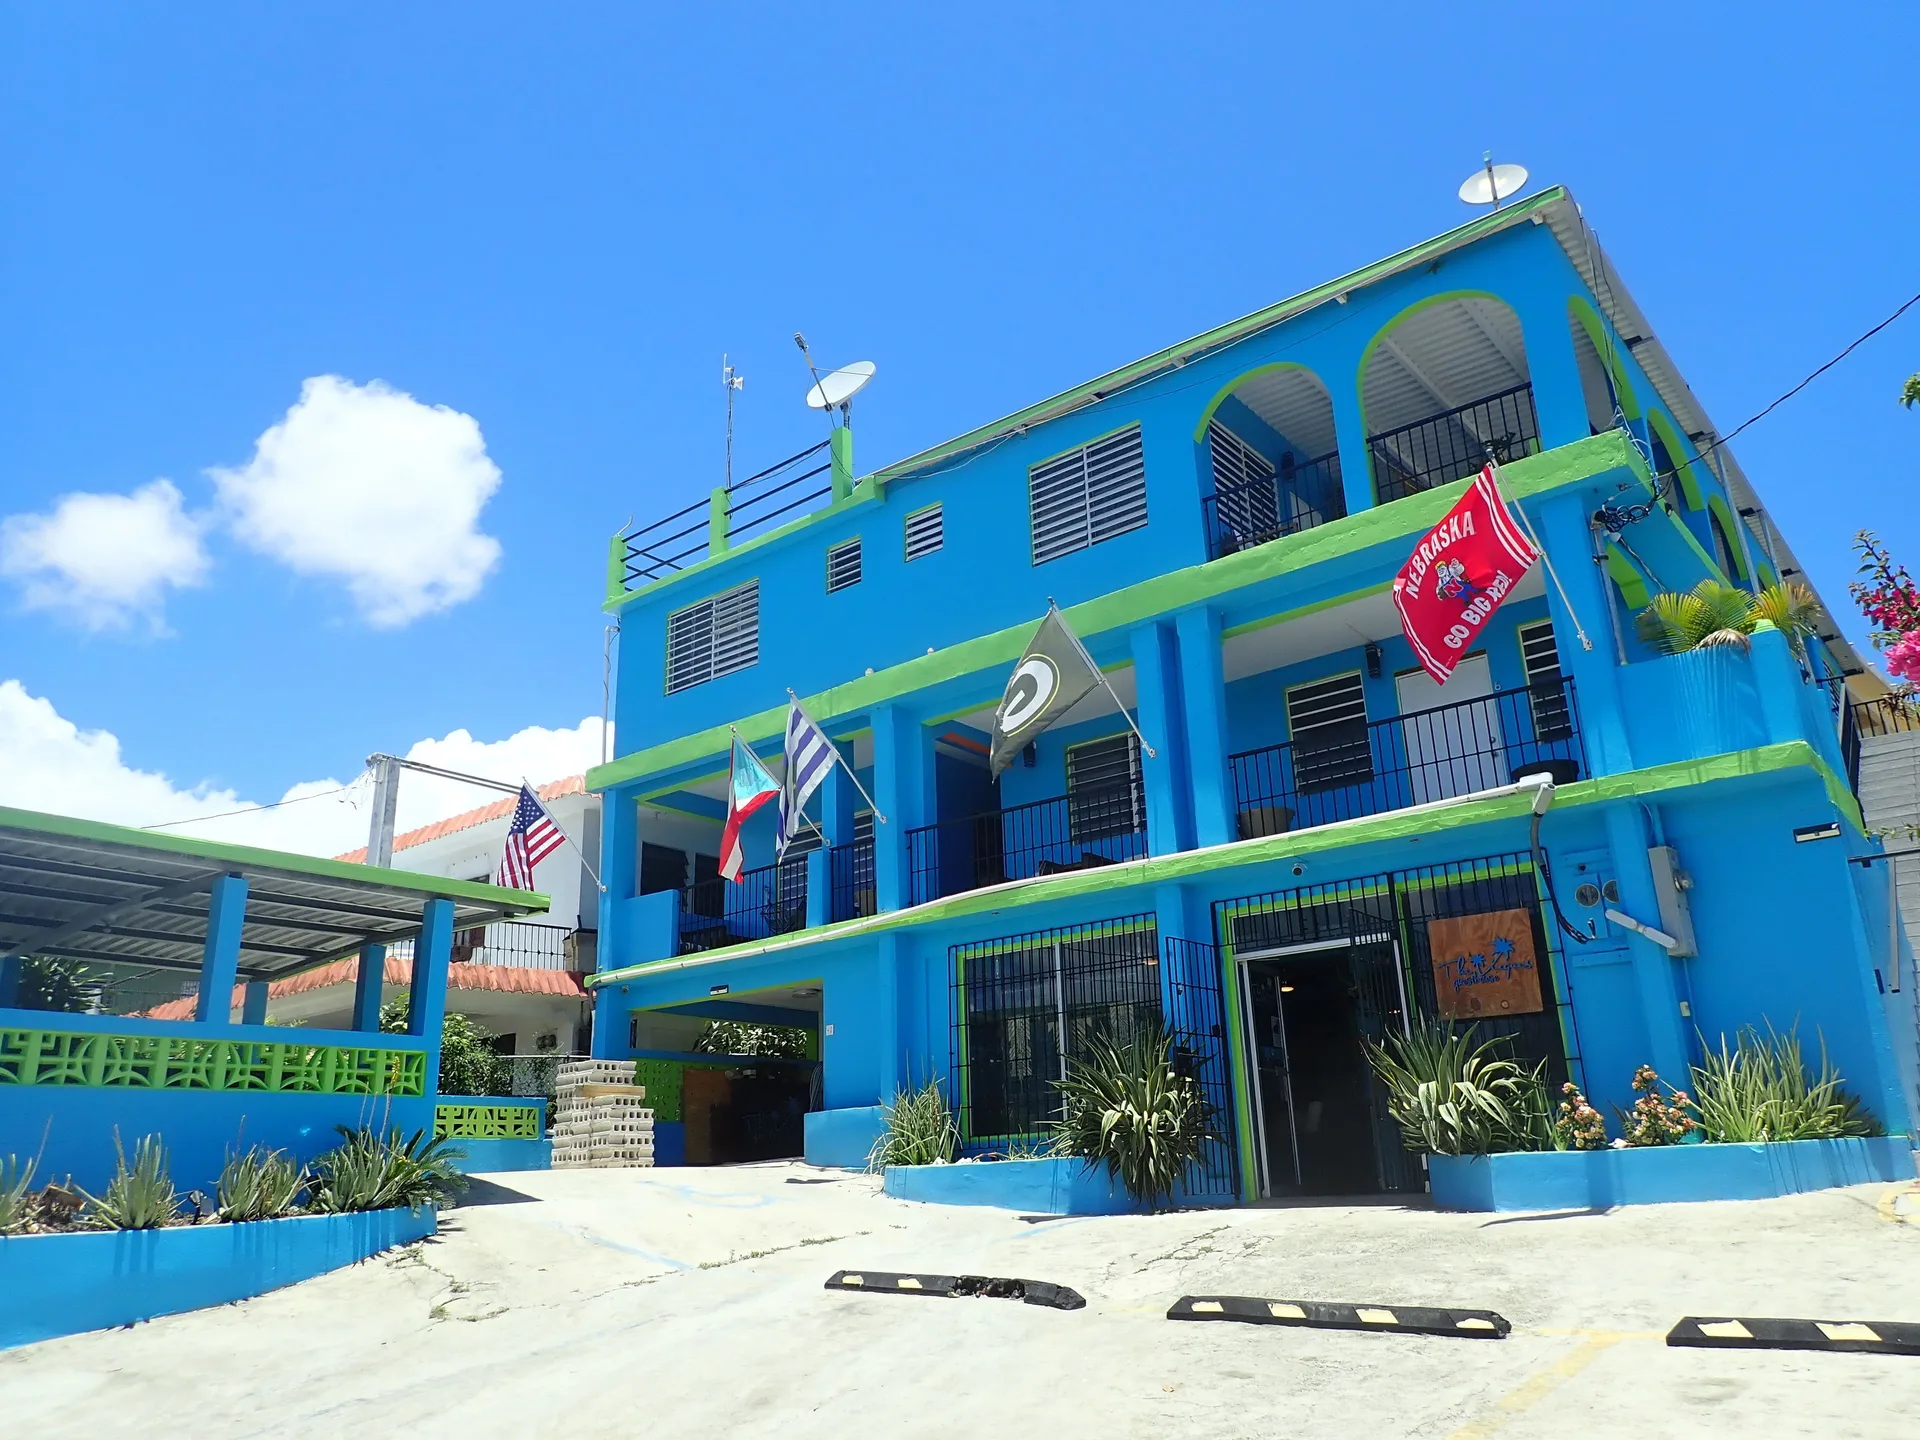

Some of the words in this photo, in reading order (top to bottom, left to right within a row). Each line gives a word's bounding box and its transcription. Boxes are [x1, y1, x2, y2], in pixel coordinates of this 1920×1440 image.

[1405, 510, 1477, 600] NEBRASKA
[1444, 623, 1470, 649] GO
[1461, 596, 1492, 626] BIG
[1486, 570, 1513, 603] RED!
[1438, 956, 1471, 979] The
